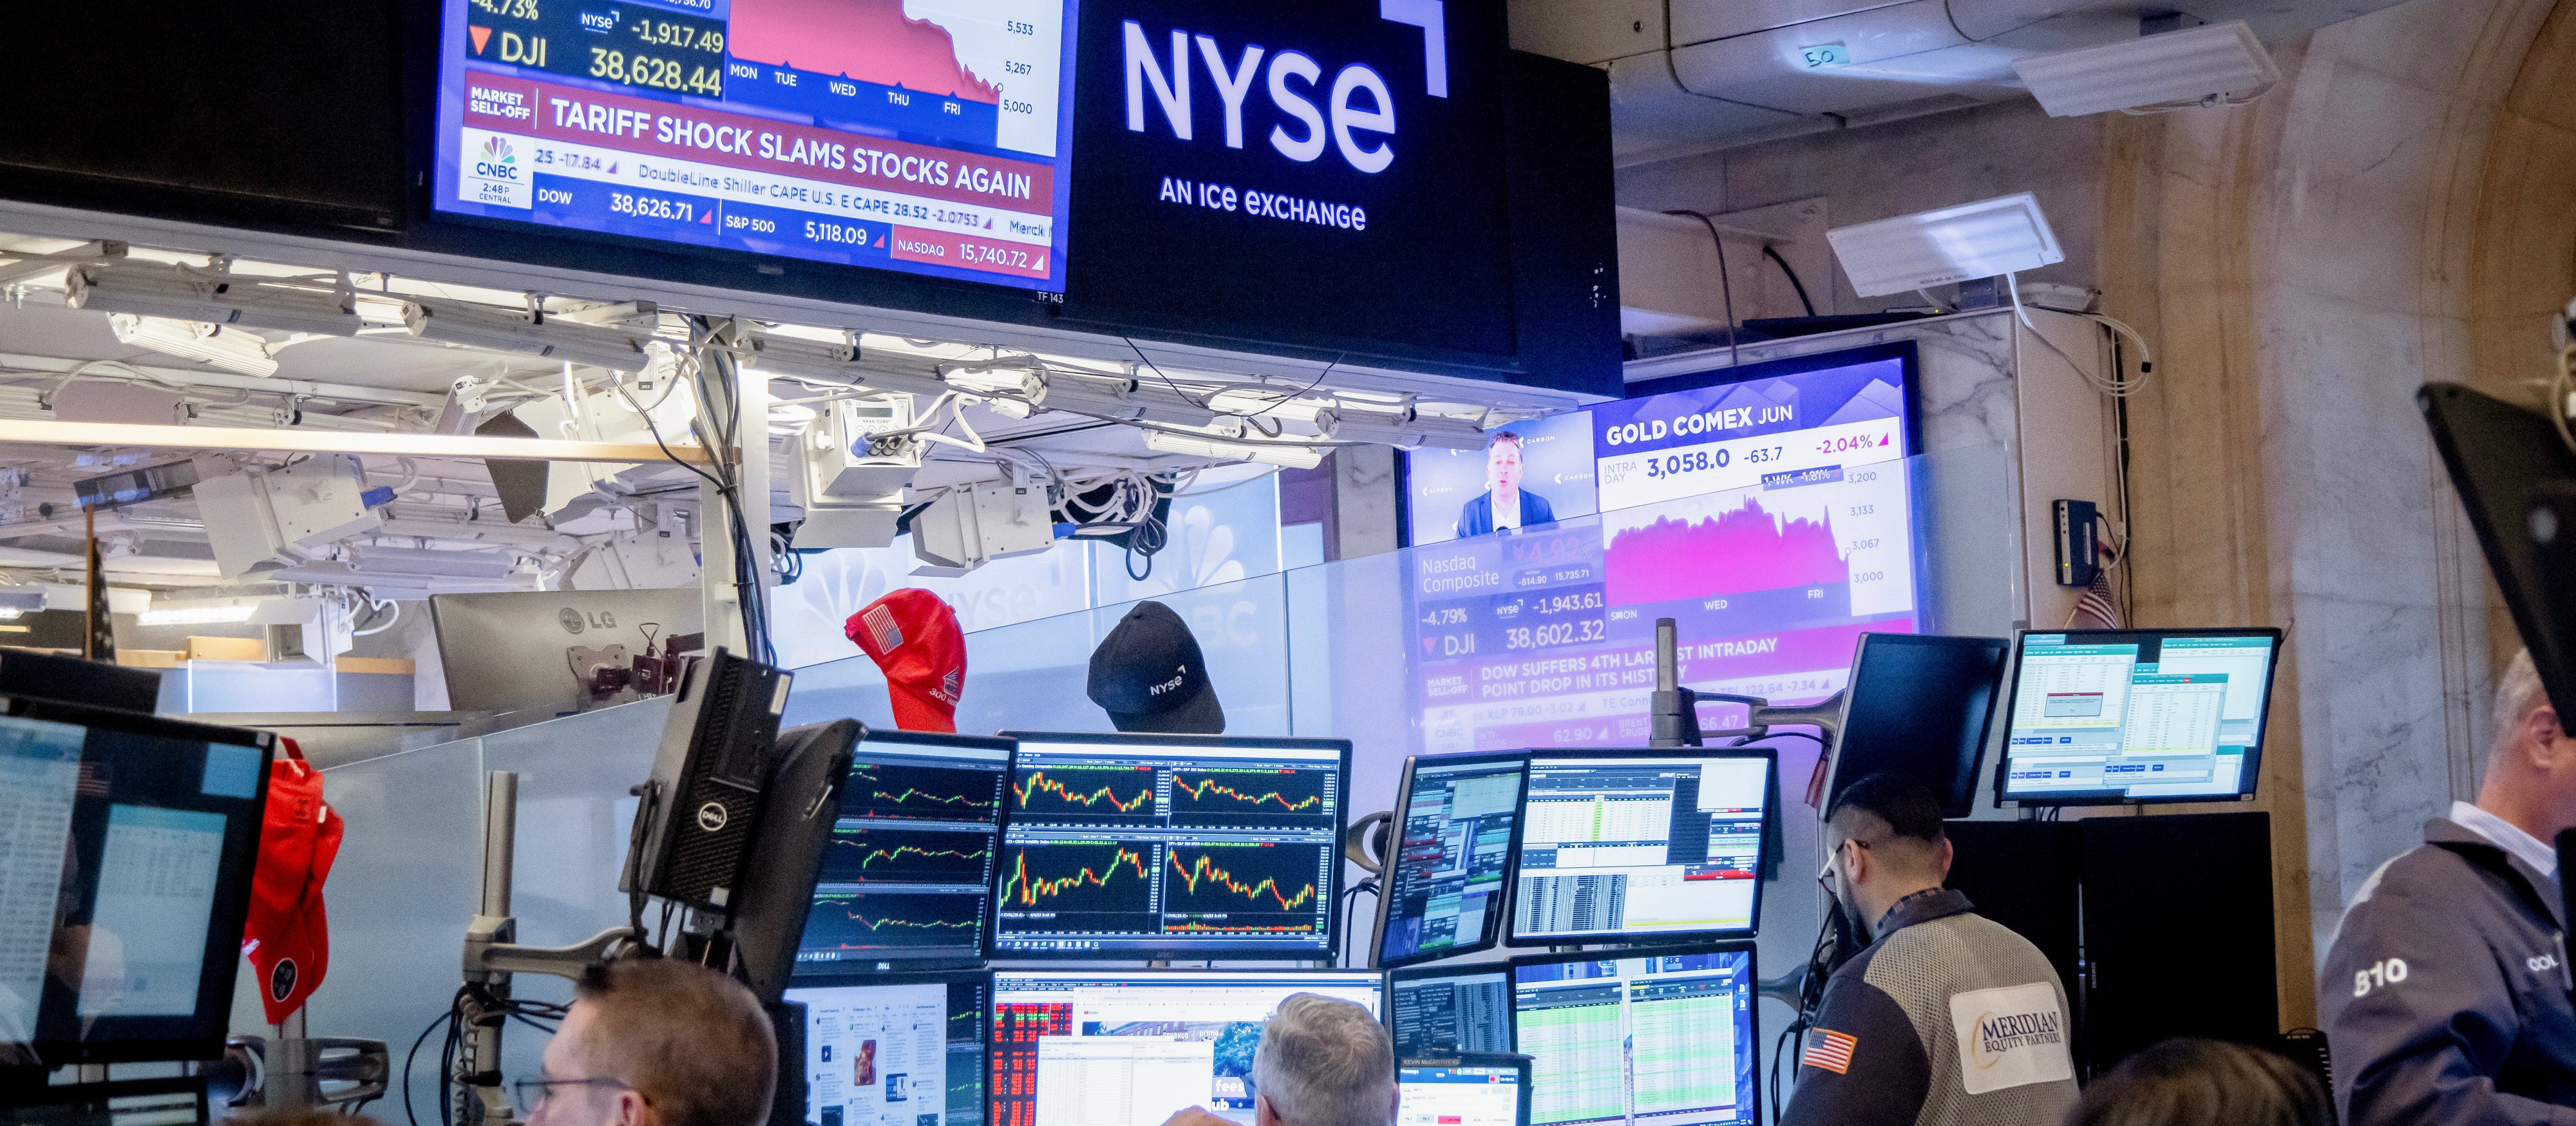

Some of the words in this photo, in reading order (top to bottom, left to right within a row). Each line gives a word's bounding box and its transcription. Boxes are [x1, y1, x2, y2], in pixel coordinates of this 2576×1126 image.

[632, 19, 724, 53] -1,917.49
[1007, 20, 1034, 36] 5,533
[502, 32, 546, 67] DJI
[591, 47, 722, 97] 38,628.44
[730, 64, 758, 80] MON
[1005, 61, 1032, 77] 5,267
[775, 72, 797, 87] TUE
[471, 87, 523, 107] MARKET
[830, 81, 857, 97] WED
[888, 91, 909, 106] THU
[1003, 100, 1032, 115] 5,000
[471, 100, 531, 120] SELL-OFF
[944, 102, 961, 116] FRI
[551, 98, 651, 138] TARIFF
[657, 116, 753, 156] SHOCK
[759, 131, 846, 170] SLAMS
[852, 149, 949, 187] STOCKS
[955, 165, 1030, 200] AGAIN
[477, 162, 517, 180] CNBC
[479, 193, 511, 203] CENTRAL
[1160, 178, 1191, 205] AN
[539, 189, 572, 205] DOW
[611, 193, 692, 222] 38,626.71
[639, 164, 719, 189] DoubleLine
[723, 177, 765, 196] Shiller
[770, 185, 806, 203] CAPE
[853, 197, 890, 214] CAPE
[893, 203, 929, 220] 28.52
[1010, 220, 1046, 238] Merck
[726, 215, 748, 230] S&P
[752, 218, 775, 234] 500
[805, 221, 867, 247] 5,118.09
[898, 239, 945, 258] NASDAQ
[960, 243, 1027, 268] 15,740.72
[1037, 292, 1047, 301] TF
[1050, 293, 1063, 303] 143
[1606, 420, 1667, 446] GOLD
[1673, 406, 1753, 436] COMEX
[1757, 404, 1792, 425] JUN
[1605, 461, 1637, 474] INTRA
[1647, 449, 1730, 480] 3,058.0
[1744, 447, 1783, 463] -63.7
[1816, 435, 1873, 454] -2.04%
[1605, 473, 1625, 483] DAY
[1848, 472, 1876, 484] 3,200
[1850, 505, 1874, 516] 3,133
[1852, 539, 1879, 550] 3,067
[1423, 556, 1475, 574] Nasdaq
[1423, 571, 1499, 593] Composite
[1854, 572, 1883, 583] 3,000
[1808, 590, 1823, 599] FRI
[1533, 593, 1604, 615] -1,943.61
[1705, 600, 1727, 610] WED
[587, 611, 617, 628] LG
[1422, 608, 1466, 626] -4.79%
[1506, 619, 1605, 650] 38,602.32
[1444, 633, 1475, 656] DJI
[1482, 665, 1517, 680] DOW
[1522, 657, 1586, 677] SUFFERS
[1591, 654, 1620, 669] 4TH
[1625, 646, 1693, 664] LARST
[1698, 637, 1777, 659] INTRADAY
[1483, 681, 1526, 698] POINT
[1531, 677, 1571, 693] DROP
[1577, 676, 1590, 689] IN
[1596, 672, 1618, 686] ITS
[1622, 665, 1687, 684] HISTY
[1553, 727, 1592, 742] 62.90
[1982, 1011, 2058, 1040] MERIDIAN
[1985, 1036, 2023, 1053] EQUITY
[2025, 1033, 2061, 1046] PARTNERS
[1216, 1080, 1245, 1092] fees
